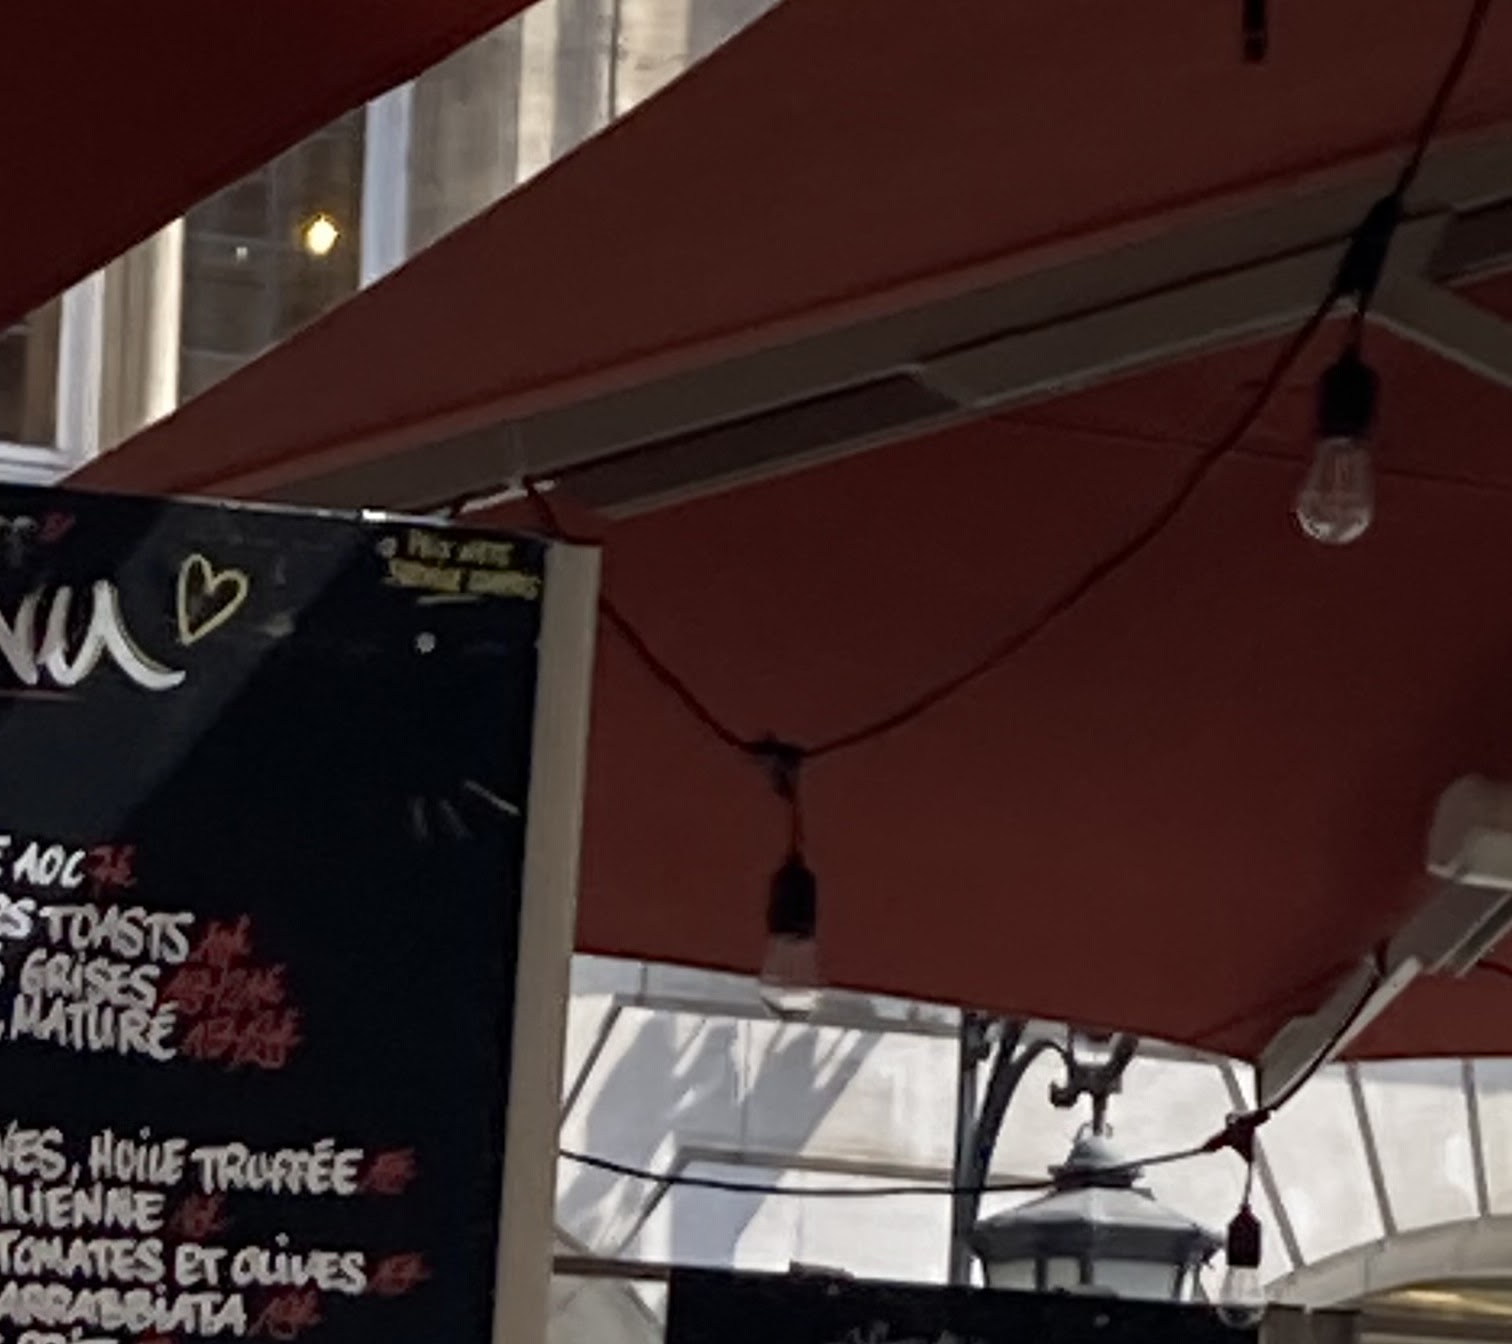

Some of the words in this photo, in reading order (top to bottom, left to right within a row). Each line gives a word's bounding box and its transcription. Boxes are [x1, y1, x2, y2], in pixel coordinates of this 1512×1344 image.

[12, 842, 86, 887] AOC
[40, 905, 195, 963] TOASTS
[19, 947, 161, 1008] GRISES
[174, 1242, 227, 1286] ET
[230, 1232, 367, 1295] OLIVES
